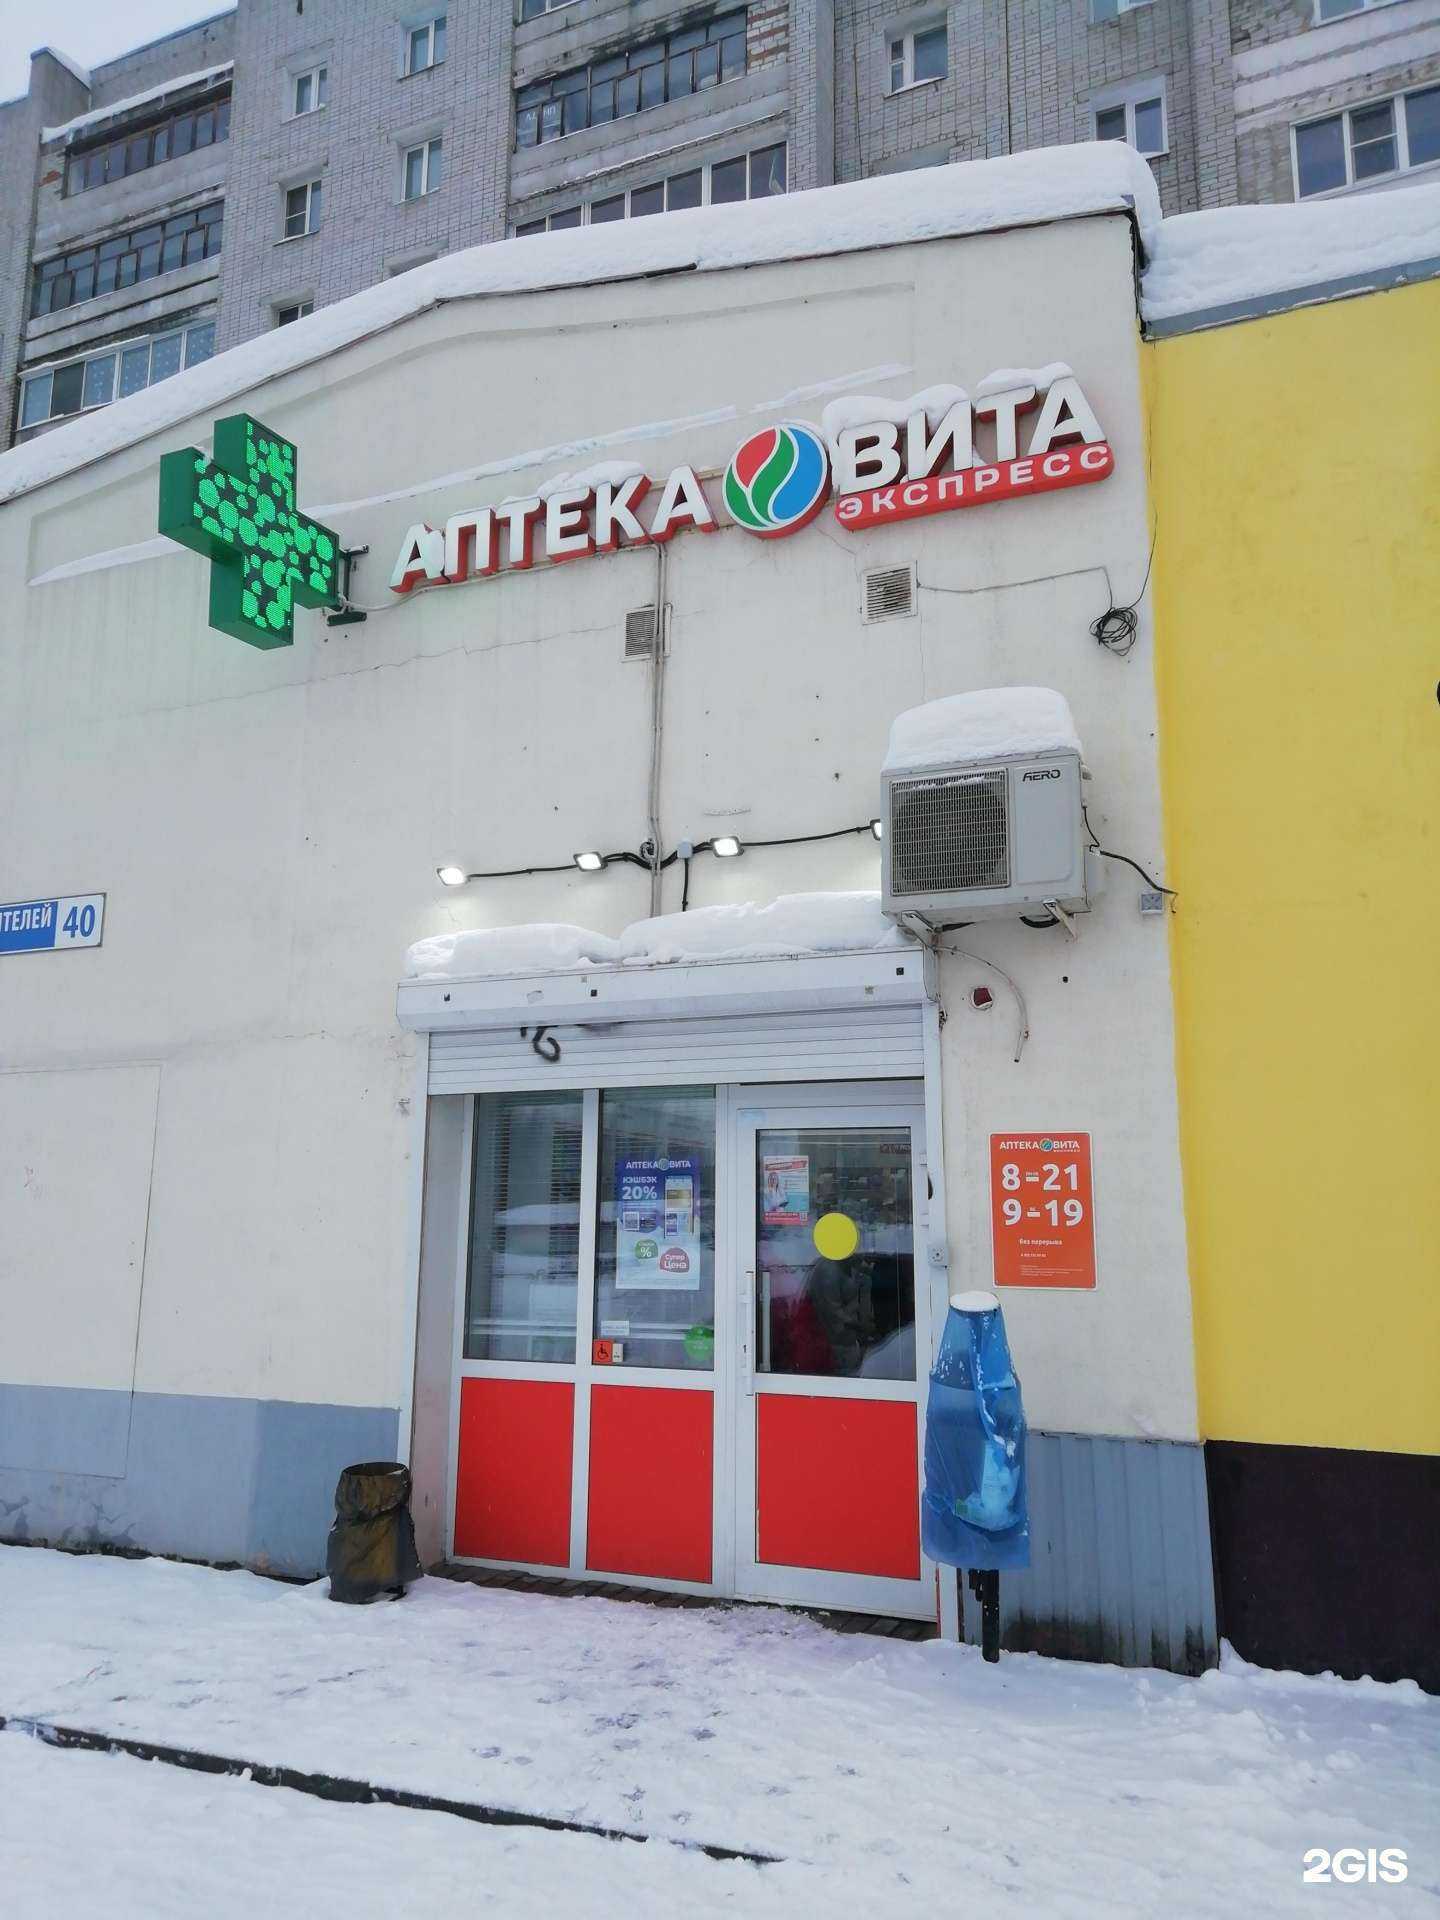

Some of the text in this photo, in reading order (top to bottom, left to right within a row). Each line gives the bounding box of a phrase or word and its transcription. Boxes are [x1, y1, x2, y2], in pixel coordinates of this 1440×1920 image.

[389, 376, 1108, 592] АПТЕКА ВИТА
[838, 446, 1108, 519] ЭКСПРЕСС
[1022, 769, 1061, 782] AERO
[62, 904, 96, 938] 40
[1000, 1140, 1080, 1150] АПТЕКА ВИТА
[626, 1160, 691, 1169] АПТЕКА ВИТА
[622, 1186, 657, 1200] 20%
